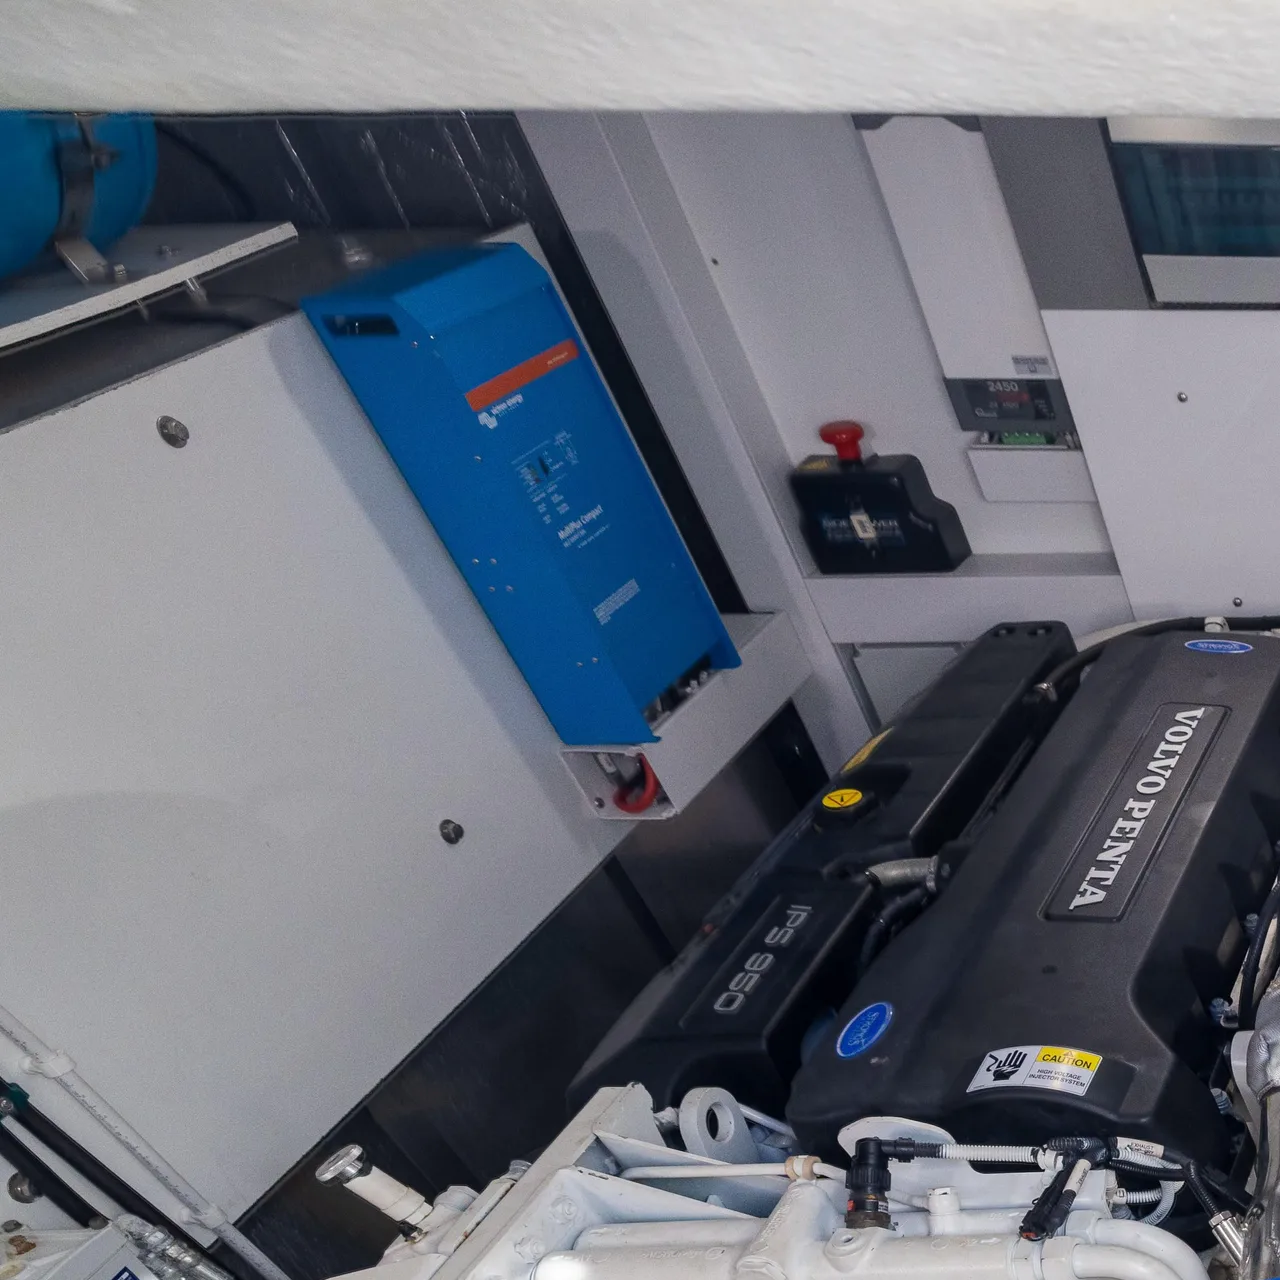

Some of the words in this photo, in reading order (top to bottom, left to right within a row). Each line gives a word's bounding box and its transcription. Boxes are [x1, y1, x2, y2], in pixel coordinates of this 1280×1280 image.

[1136, 707, 1206, 795] VOLVO
[1068, 798, 1156, 911] PENTA
[764, 904, 813, 945] IPS
[713, 952, 774, 1012] 950
[1028, 1073, 1060, 1082] INJECTOR
[1060, 1077, 1086, 1088] SYSTEM
[1037, 1068, 1054, 1076] HIGH
[1053, 1070, 1082, 1080] VOLTAGE
[1042, 1053, 1093, 1069] CAUTION
